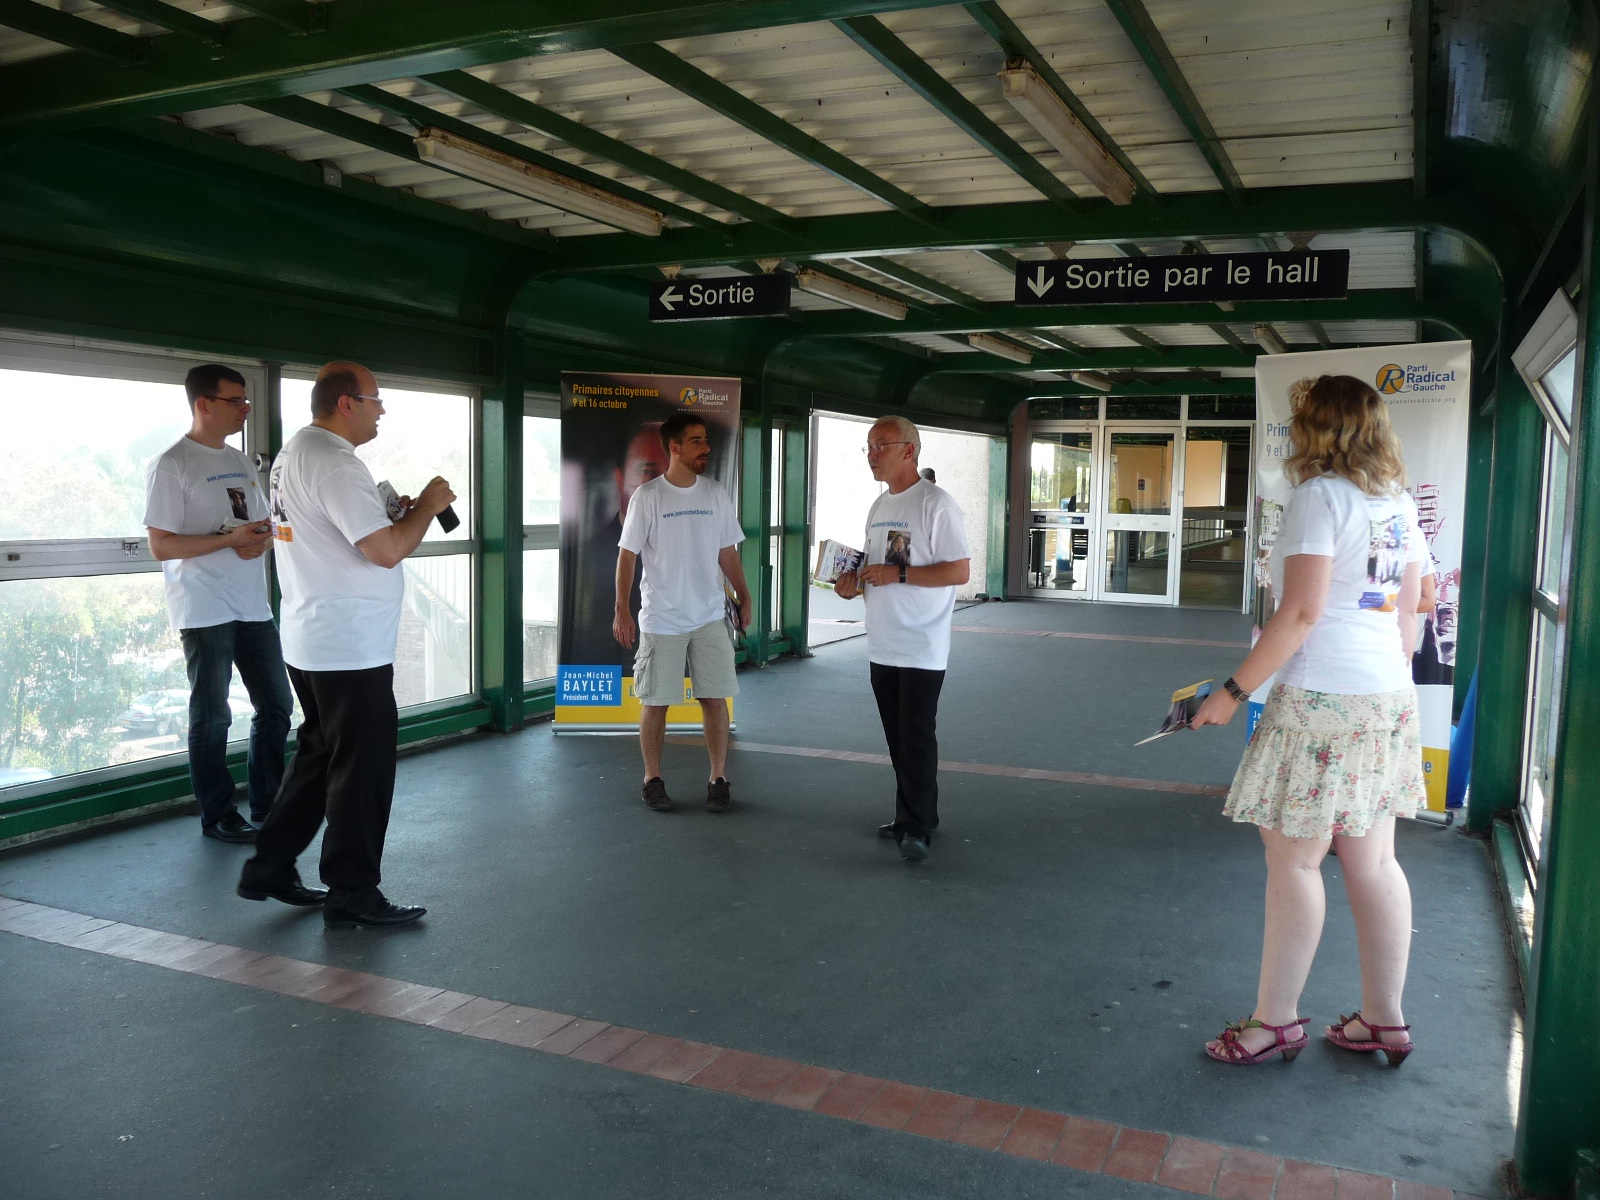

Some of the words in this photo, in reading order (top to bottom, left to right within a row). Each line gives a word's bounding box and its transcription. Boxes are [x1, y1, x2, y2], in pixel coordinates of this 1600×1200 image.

[1065, 263, 1150, 290] Sortie
[1164, 265, 1212, 292] par
[1226, 259, 1251, 285] le
[1266, 256, 1319, 284] hall
[688, 281, 755, 306] Sortie
[1406, 364, 1428, 373] Parti
[1406, 370, 1456, 383] Radical
[572, 383, 613, 396] Primaires
[614, 385, 659, 398] citoyennes
[1412, 383, 1446, 391] Gauche
[698, 393, 729, 401] Radical
[572, 398, 578, 407] 9
[579, 398, 587, 408] et
[589, 398, 597, 408] 16
[599, 399, 627, 409] octobre
[1266, 444, 1272, 457] 9
[1273, 445, 1283, 457] et
[563, 671, 613, 679] Jean-Michel
[563, 680, 613, 692] BAYLET
[563, 693, 589, 701] Président
[591, 693, 599, 701] du
